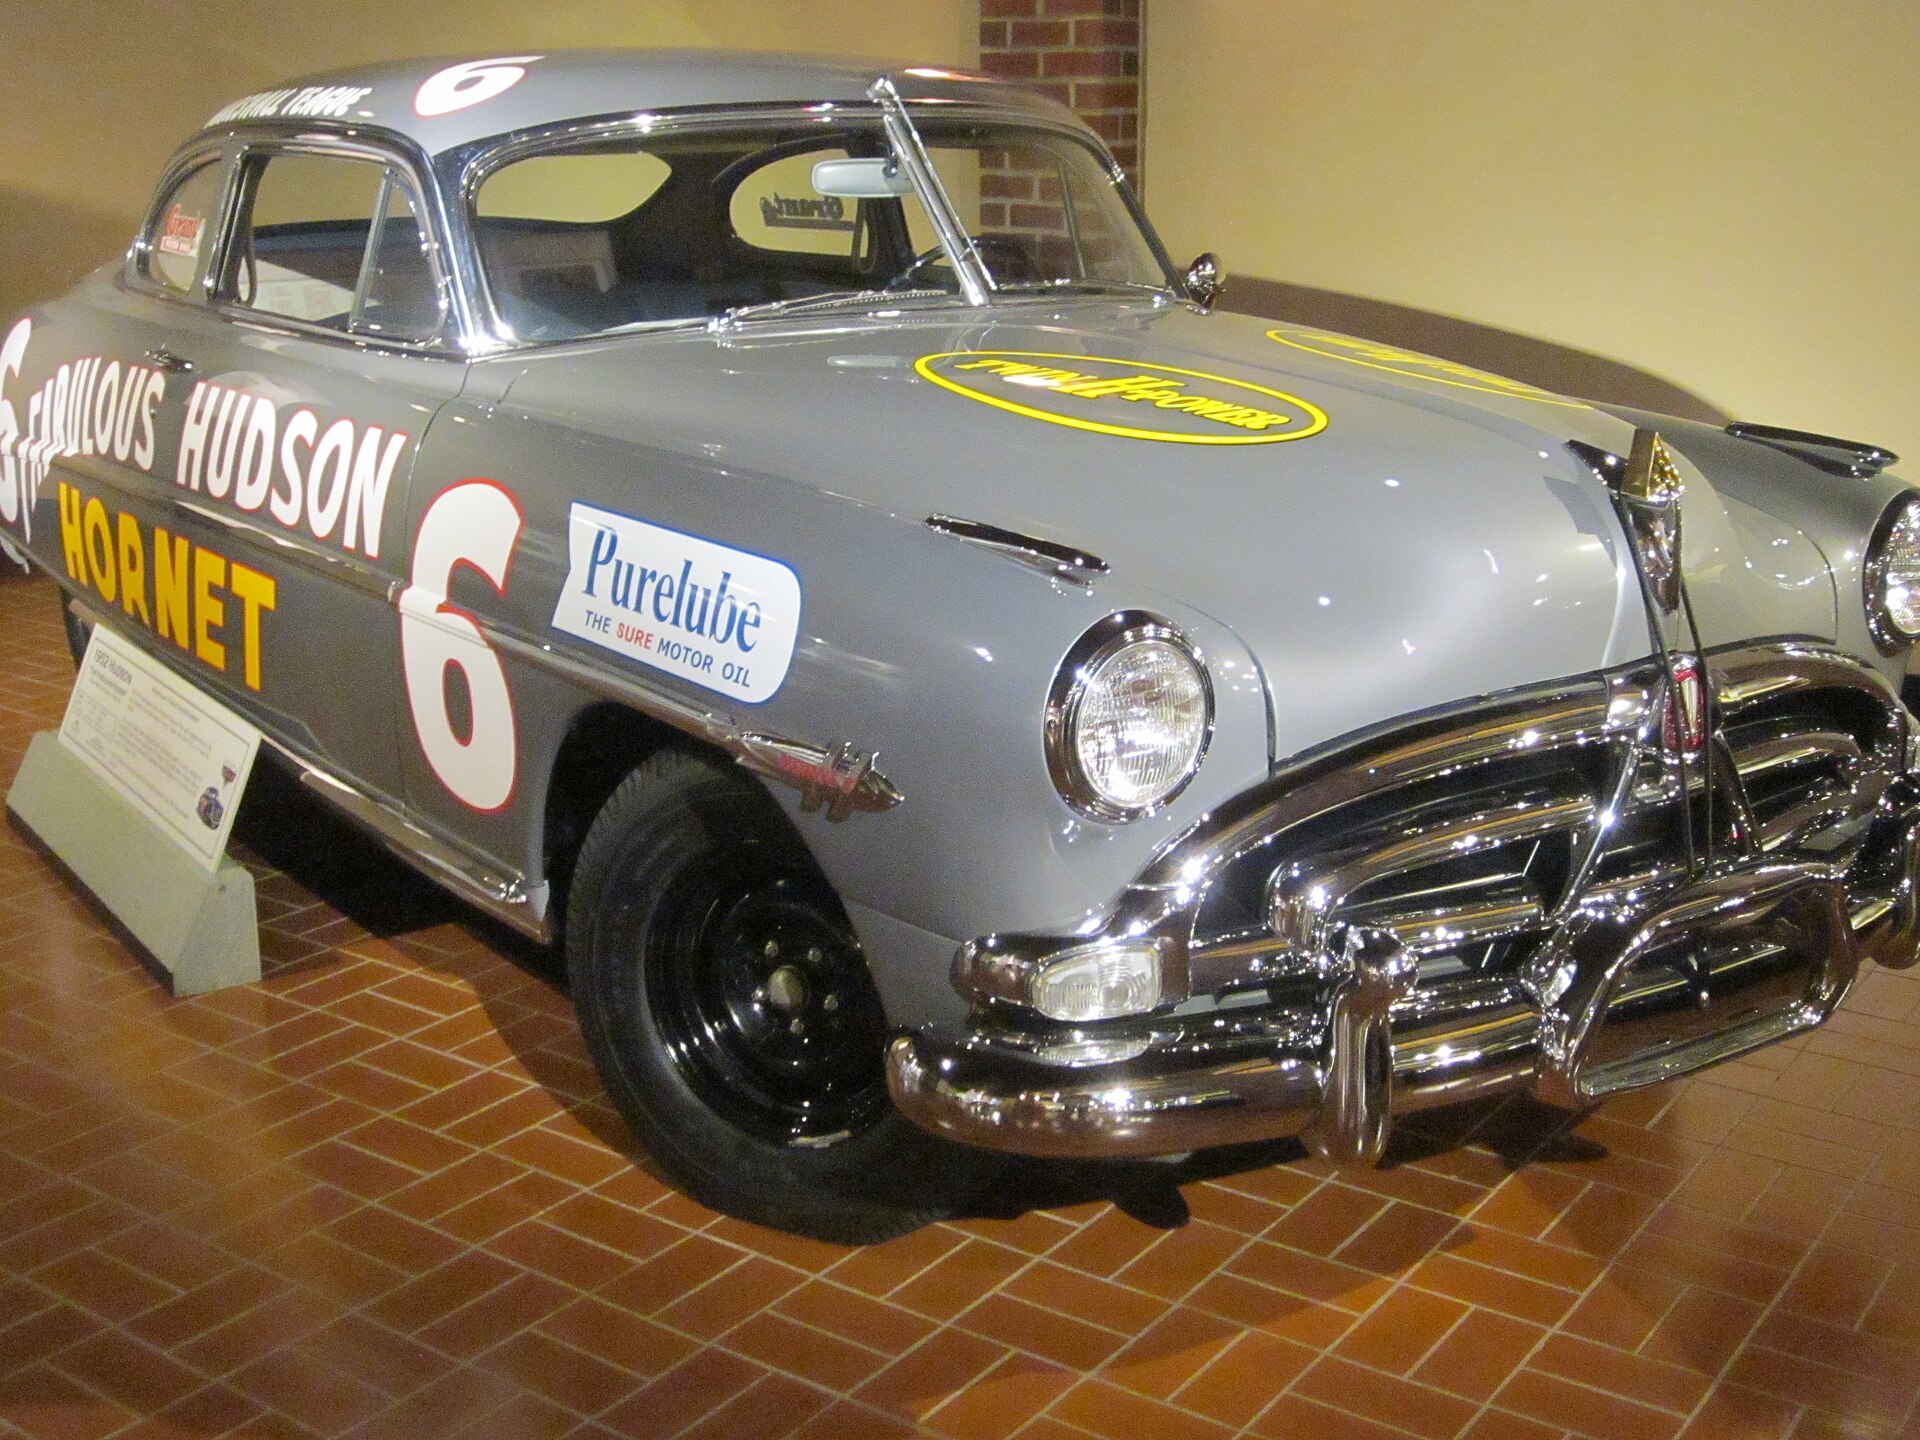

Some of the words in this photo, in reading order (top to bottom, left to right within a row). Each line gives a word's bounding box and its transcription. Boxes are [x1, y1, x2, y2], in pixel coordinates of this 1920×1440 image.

[415, 56, 546, 117] 6
[17, 356, 166, 546] FABULOUS
[177, 381, 408, 560] HUDSON
[57, 480, 277, 691] HORNET
[398, 477, 526, 815] 6
[581, 524, 762, 653] Purelube
[584, 609, 612, 634] THE
[616, 622, 655, 650] SURE
[656, 637, 714, 674] MOTOR
[721, 662, 751, 688] OIL
